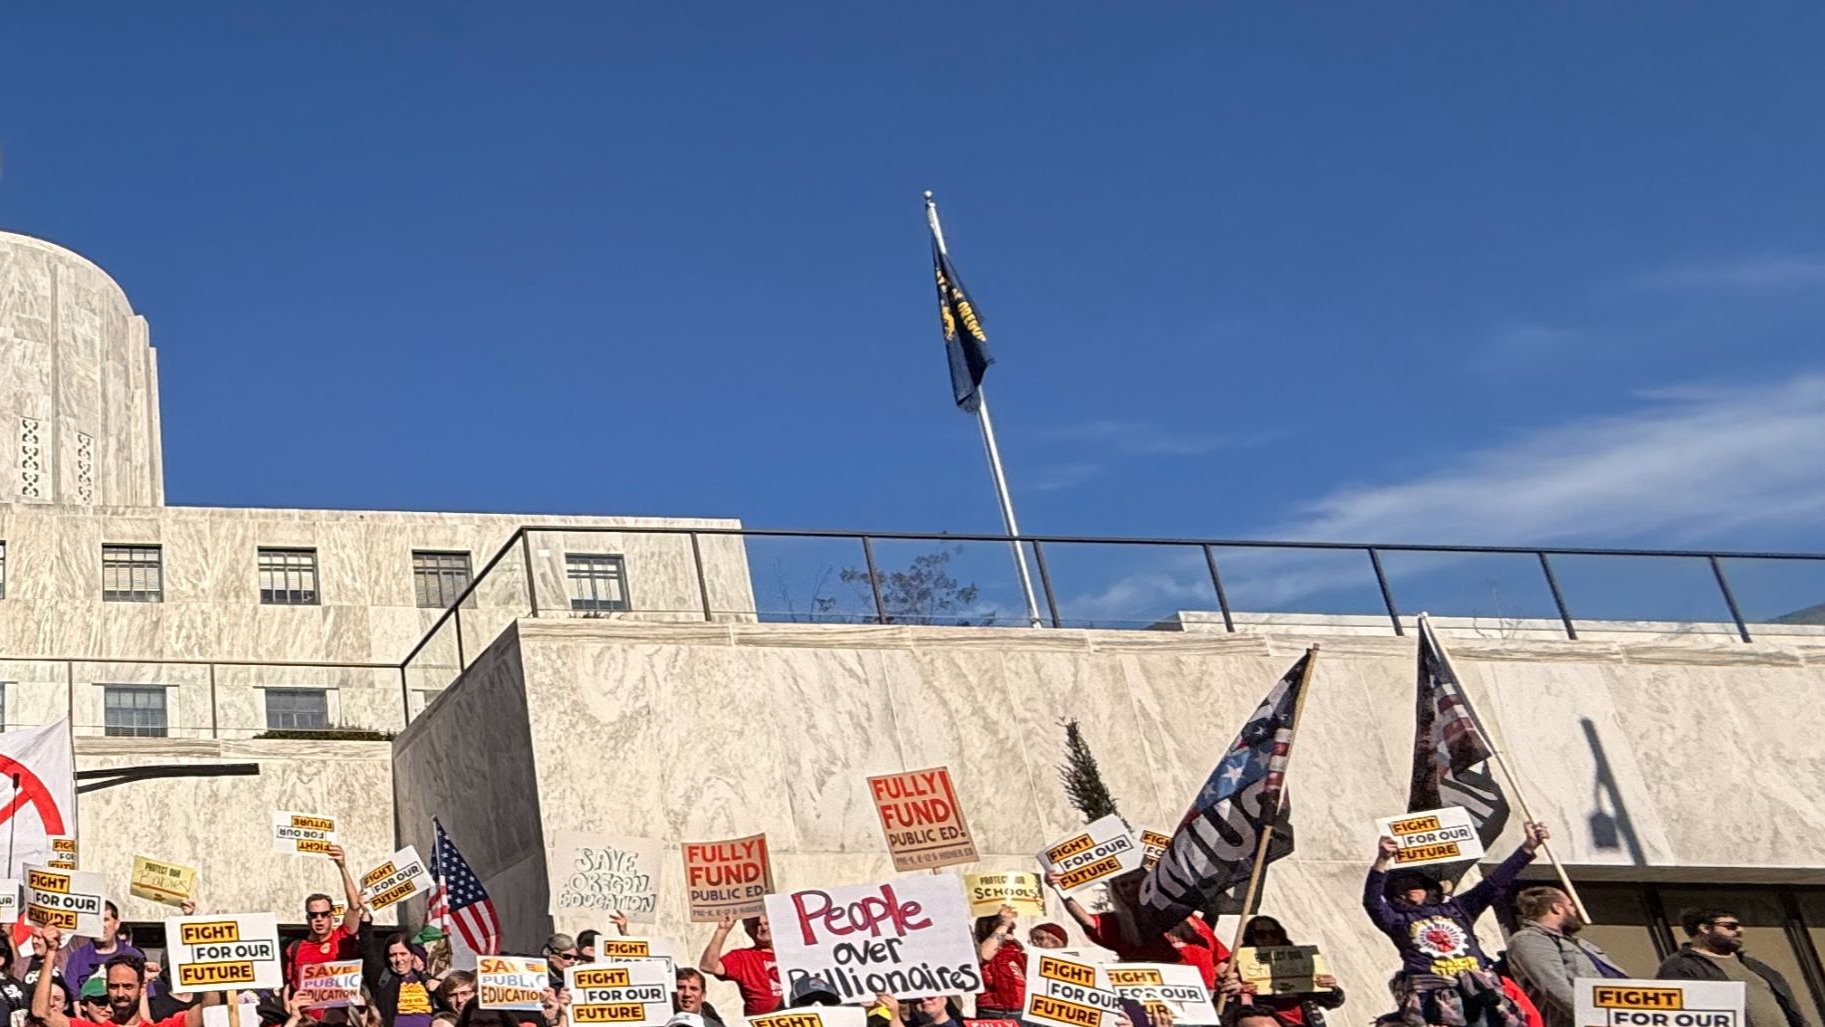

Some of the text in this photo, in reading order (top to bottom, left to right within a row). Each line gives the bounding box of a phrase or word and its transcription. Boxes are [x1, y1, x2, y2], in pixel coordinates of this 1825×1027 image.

[873, 772, 936, 799] FULLY
[293, 817, 333, 830] FUTURE
[881, 799, 950, 830] FUND
[278, 828, 325, 839] FOR OUR
[1393, 819, 1439, 834] FIGHT
[888, 831, 938, 847] PUBLIC
[1407, 827, 1471, 847] FOR OUR
[298, 841, 329, 852] FIGHT
[688, 841, 753, 863] FULLY
[1049, 837, 1091, 861] FIGHT
[1064, 838, 1128, 870] FOR OUR
[1398, 844, 1457, 861] FUTURE
[576, 848, 638, 874] SAVE
[688, 863, 760, 886] FUND
[1060, 859, 1117, 888] FUTURE
[571, 873, 650, 894] OREGON
[974, 886, 1038, 899] SCHOOLS
[558, 892, 657, 913] EDUCATION
[691, 887, 742, 901] PUBLIC
[791, 883, 932, 946] People
[185, 926, 235, 940] FIGHT
[196, 945, 270, 959] FOR OUR
[833, 936, 903, 966] over
[183, 966, 252, 982] FUTURE
[1597, 989, 1678, 1006] FIGHT
[1614, 1012, 1668, 1027] FOR
